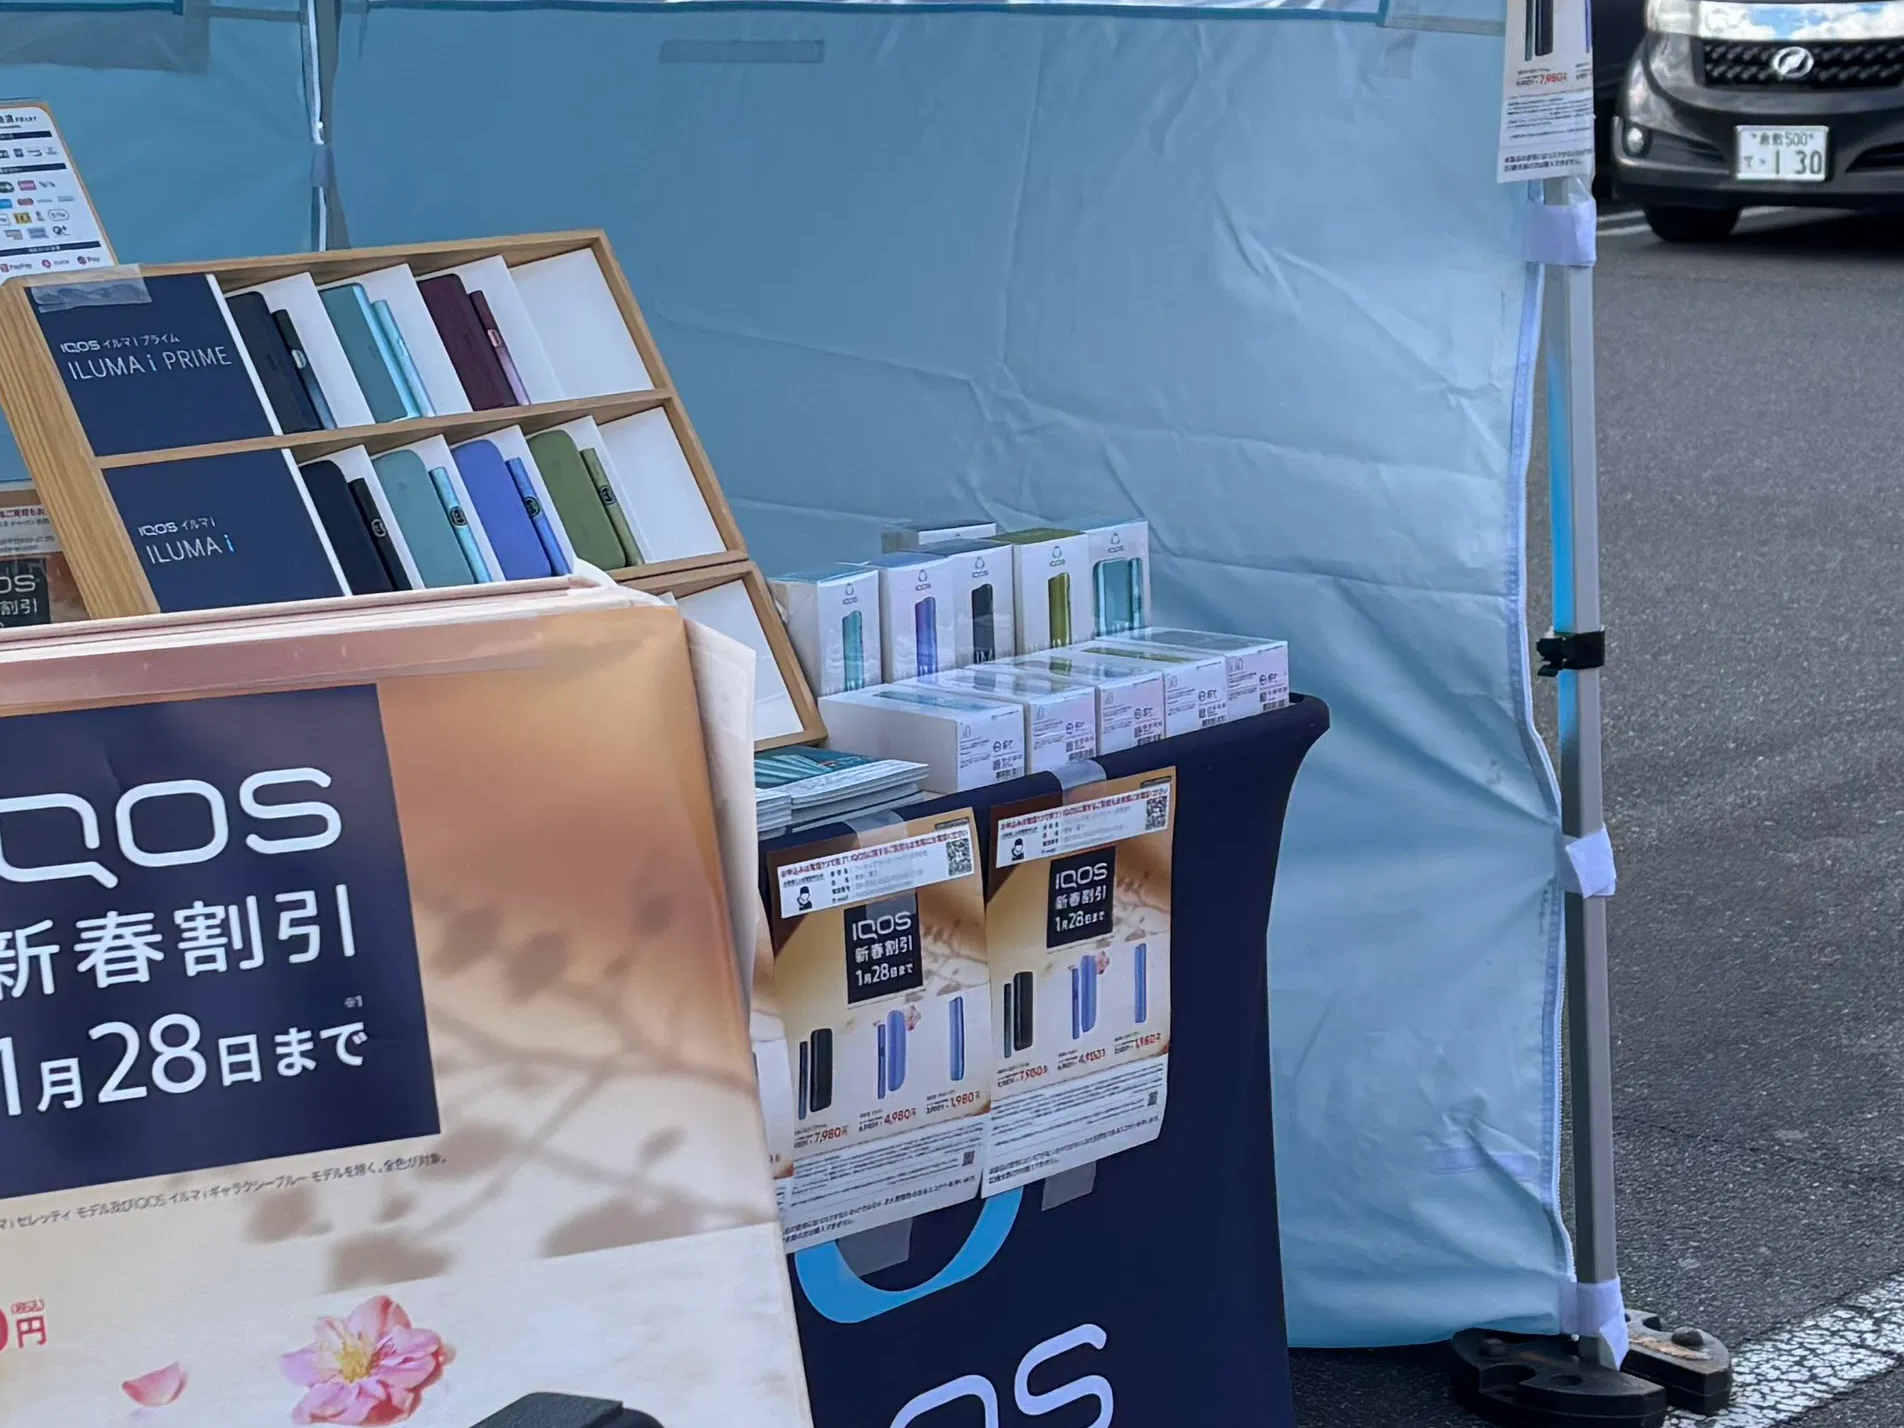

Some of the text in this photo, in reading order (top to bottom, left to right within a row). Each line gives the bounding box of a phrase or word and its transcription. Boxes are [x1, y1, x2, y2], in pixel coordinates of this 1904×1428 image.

[60, 340, 101, 354] IQOS
[68, 346, 232, 380] ILUMA i PRIME
[138, 521, 178, 536] IQOS
[146, 534, 234, 564] ILUMA i
[1055, 862, 1108, 890] IQOS
[852, 911, 912, 941] IQOS
[854, 935, 913, 963] 新春割引
[855, 961, 914, 987] 1月28日まで
